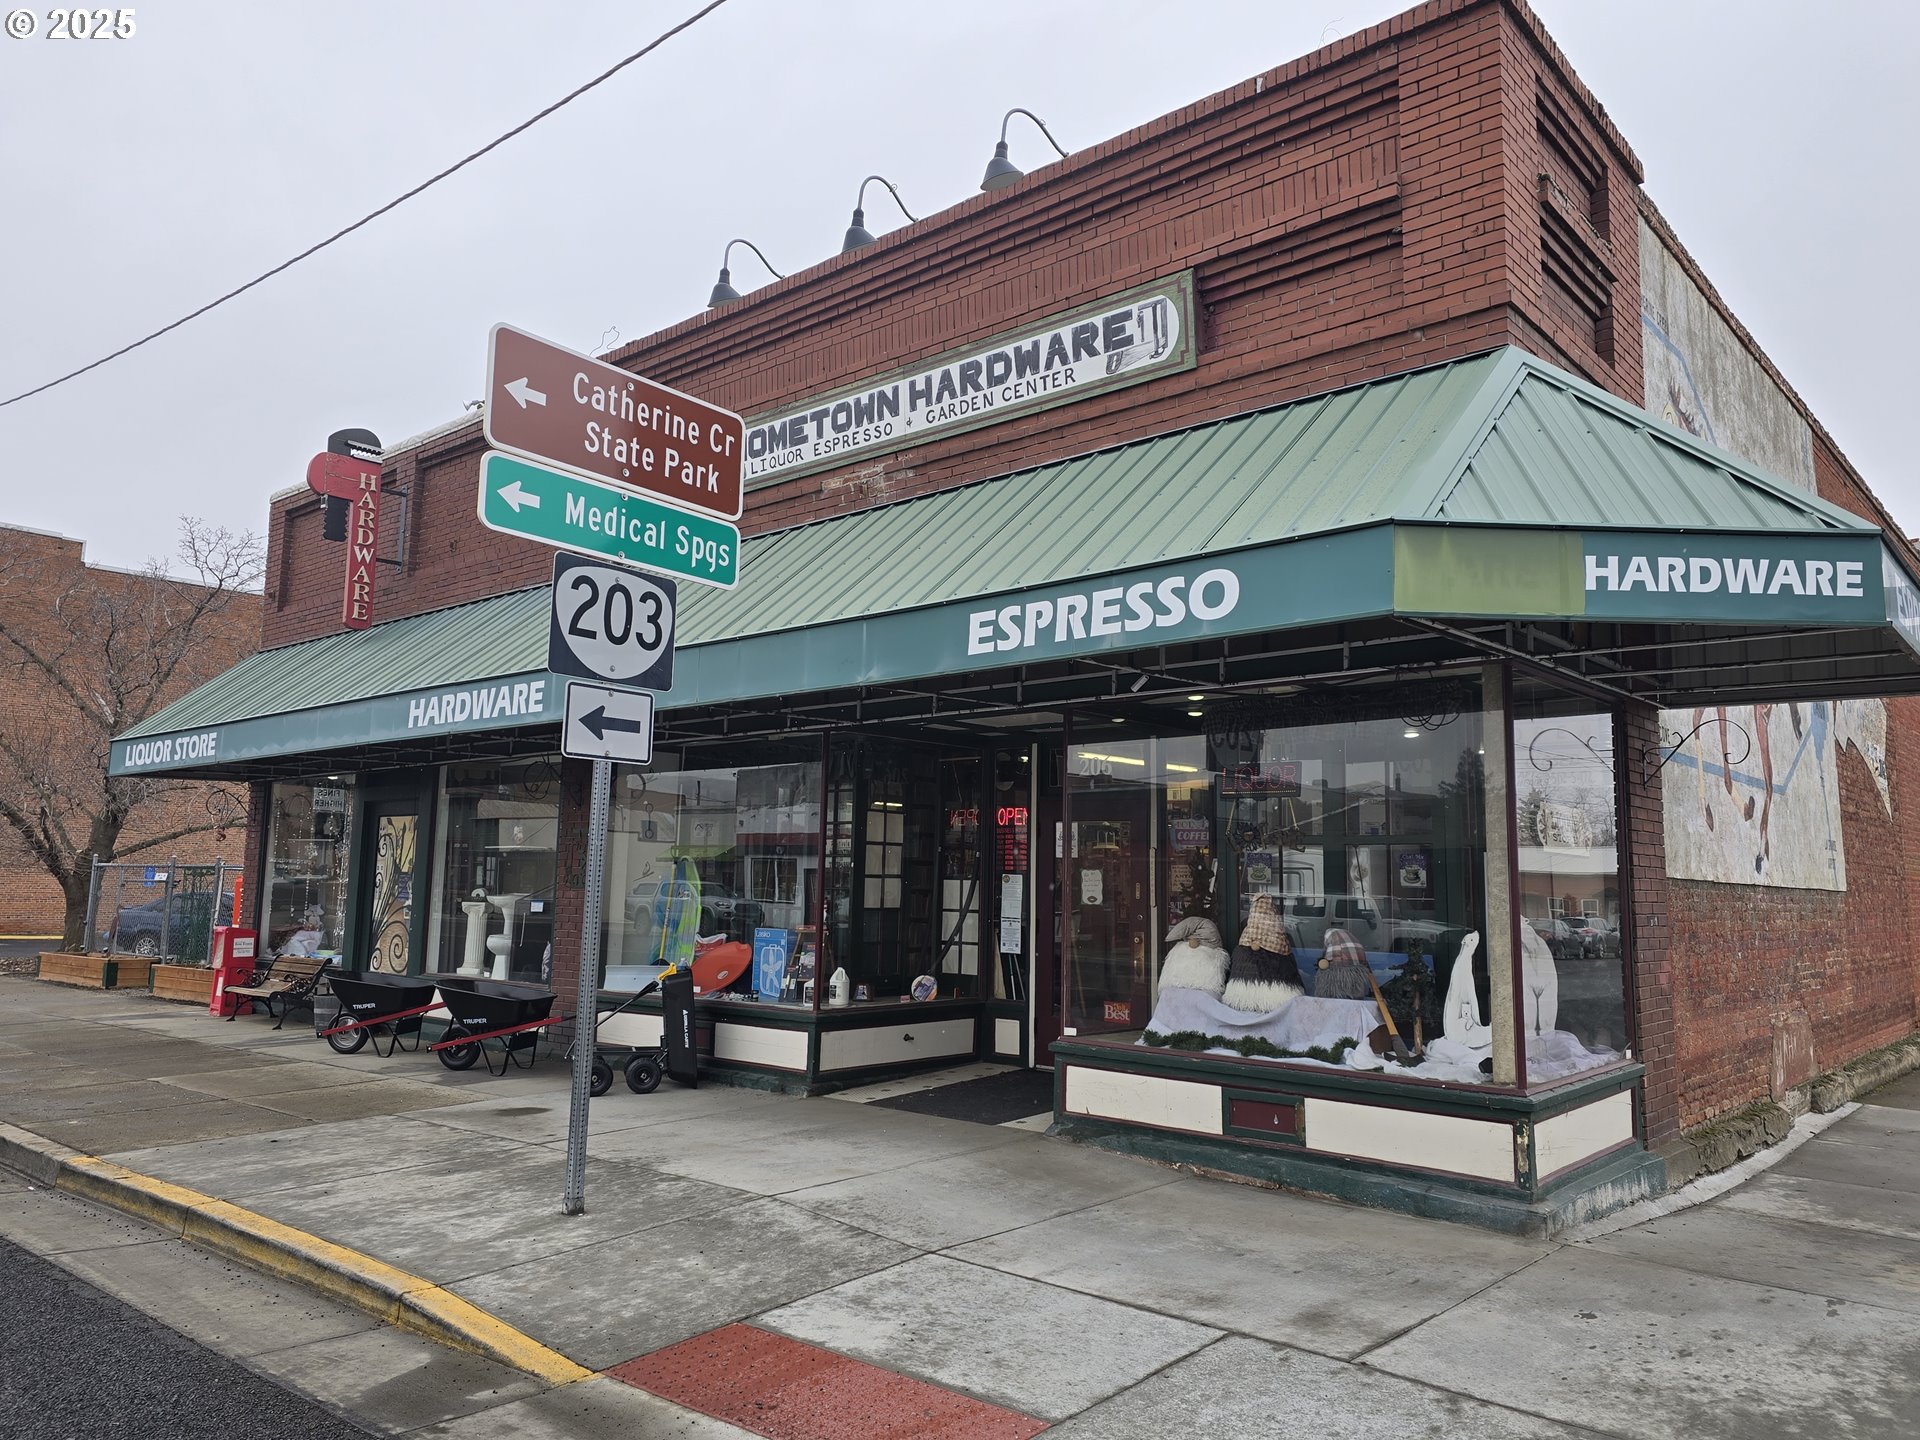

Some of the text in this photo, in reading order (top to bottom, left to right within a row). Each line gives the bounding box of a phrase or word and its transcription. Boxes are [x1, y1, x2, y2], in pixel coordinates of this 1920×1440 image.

[573, 372, 735, 456] Catherine Cr
[744, 308, 1134, 462] OMETOWN HARDWARE
[584, 421, 719, 493] State Park
[751, 448, 804, 475] LIQUOR
[814, 422, 893, 457] ESPRESSO
[926, 391, 994, 424] GARDEN
[1001, 368, 1076, 402] CENTER
[351, 471, 377, 621] HARDWARE
[565, 492, 730, 572] Medical Spgs
[967, 568, 1240, 656] ESPRESSO
[1585, 555, 1864, 597] HARDWARE
[567, 574, 663, 651] 203
[407, 680, 546, 729] HARDWARE
[125, 732, 218, 768] LIQUOR STORE
[1080, 755, 1113, 776] 206
[1222, 765, 1297, 790] LIQUOR
[462, 1017, 487, 1025] TRUPER
[1103, 1004, 1131, 1021] Best
